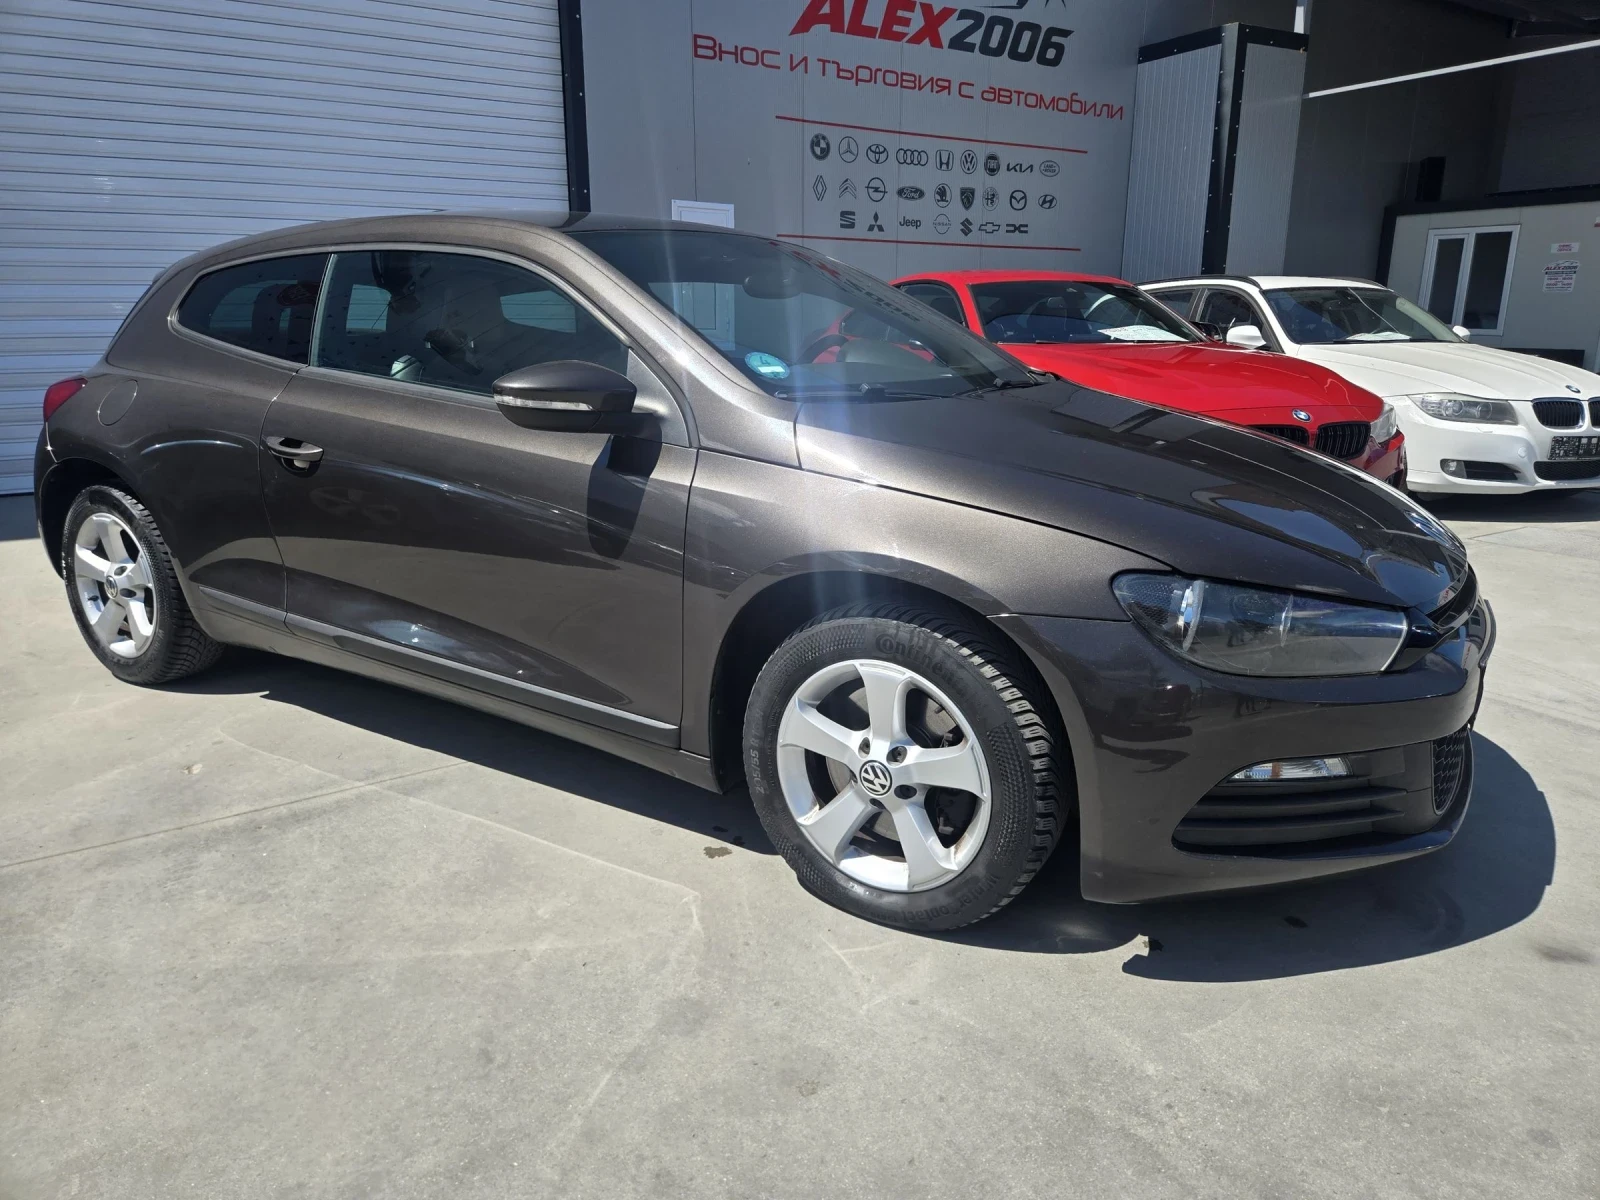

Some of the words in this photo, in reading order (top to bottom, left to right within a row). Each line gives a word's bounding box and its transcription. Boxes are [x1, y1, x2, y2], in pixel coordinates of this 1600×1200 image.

[789, 0, 1075, 67] ALEX2006
[693, 33, 781, 70] Внос
[789, 53, 809, 74] и
[816, 58, 952, 96] търговия
[958, 81, 975, 99] с
[981, 86, 1124, 120] автомобили
[899, 216, 922, 230] Jeep
